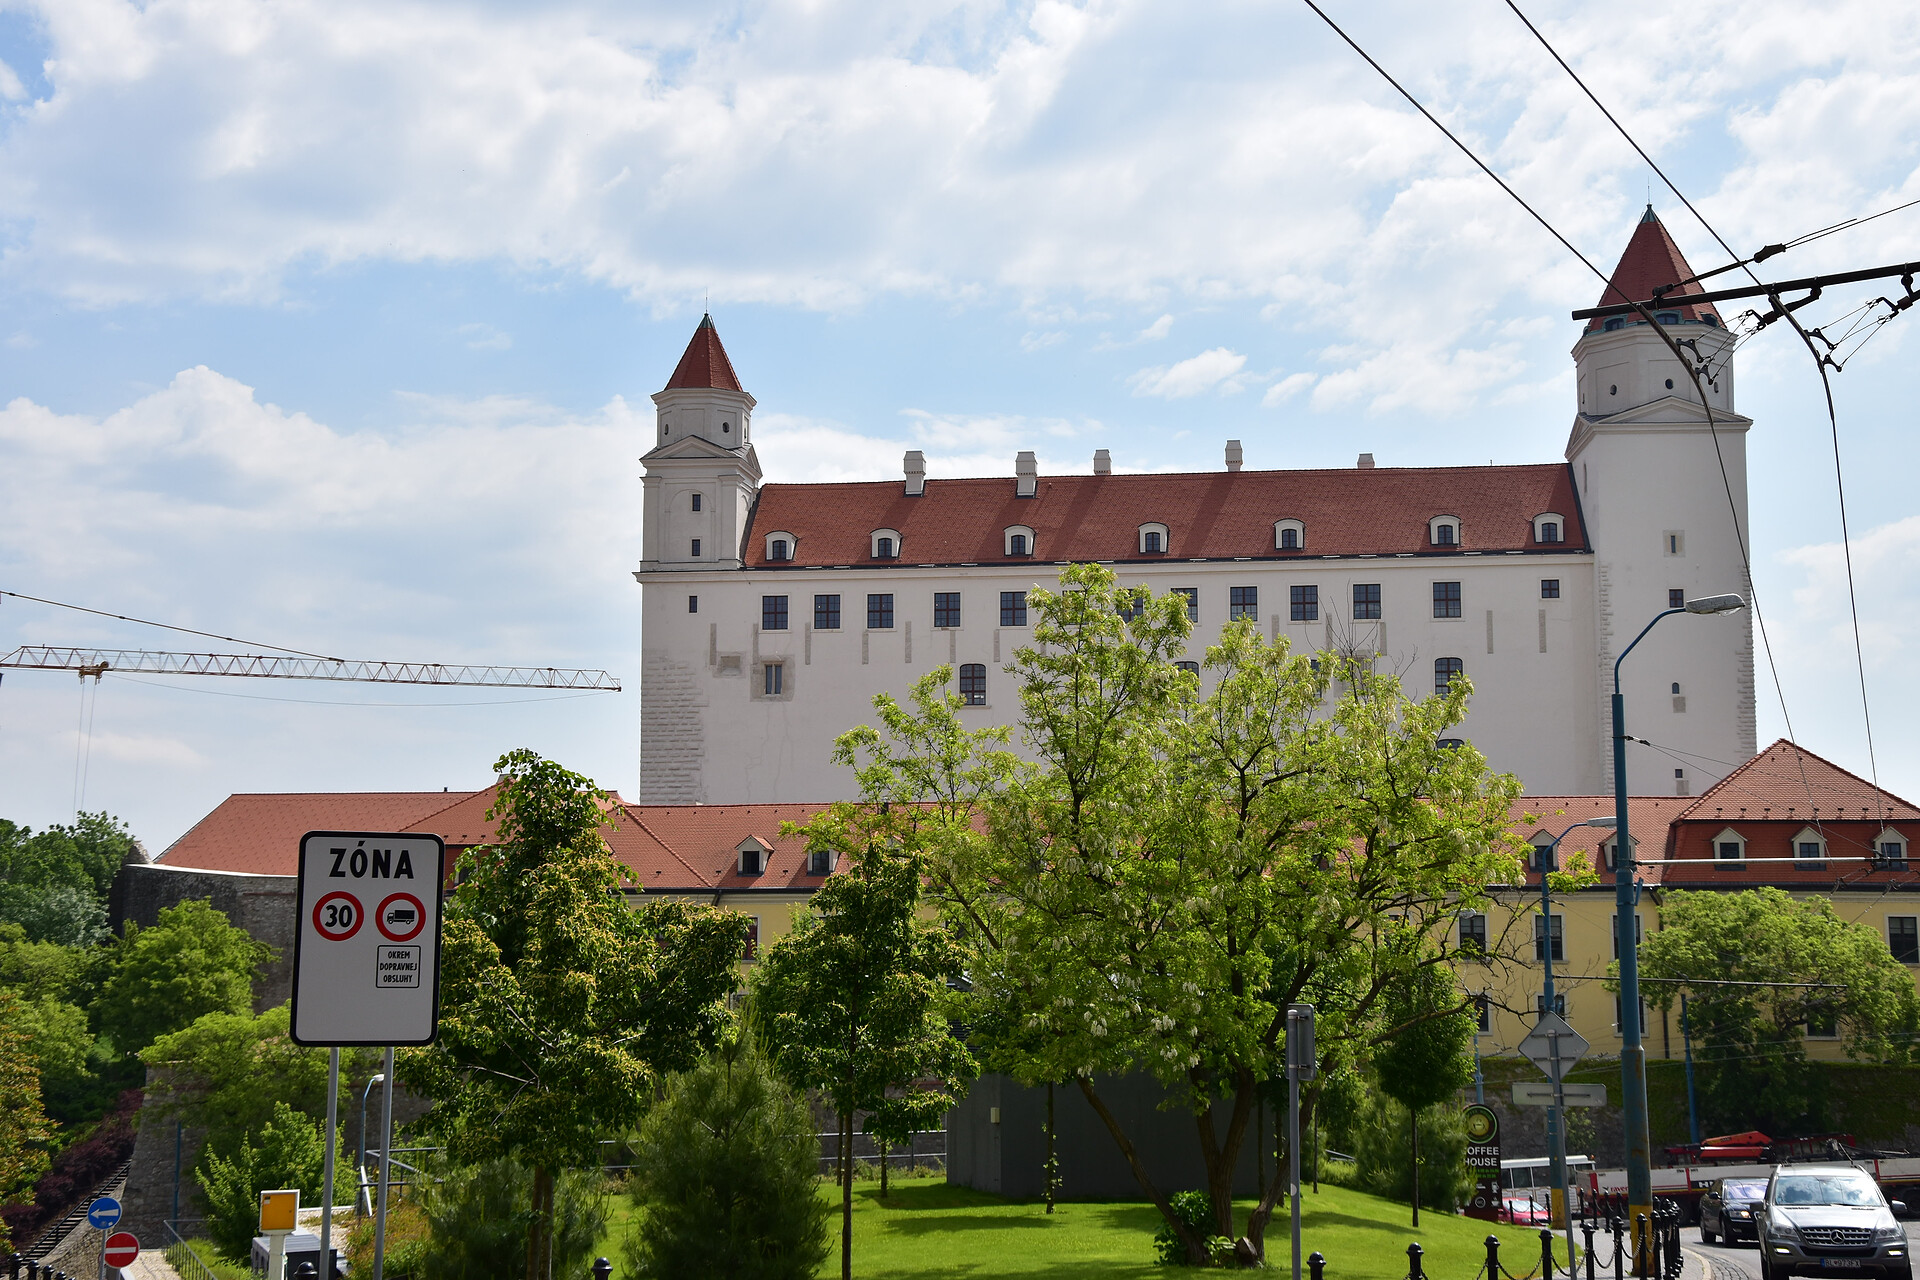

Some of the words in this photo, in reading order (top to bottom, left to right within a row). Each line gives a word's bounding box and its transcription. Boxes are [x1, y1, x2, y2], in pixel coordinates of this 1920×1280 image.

[329, 840, 414, 879] ZÓNA
[325, 904, 353, 928] 30
[387, 950, 411, 960] OKREM
[379, 962, 418, 971] DOPRAVNEJ
[382, 974, 413, 983] OBSLUHY
[1464, 1146, 1500, 1156] OFFEE
